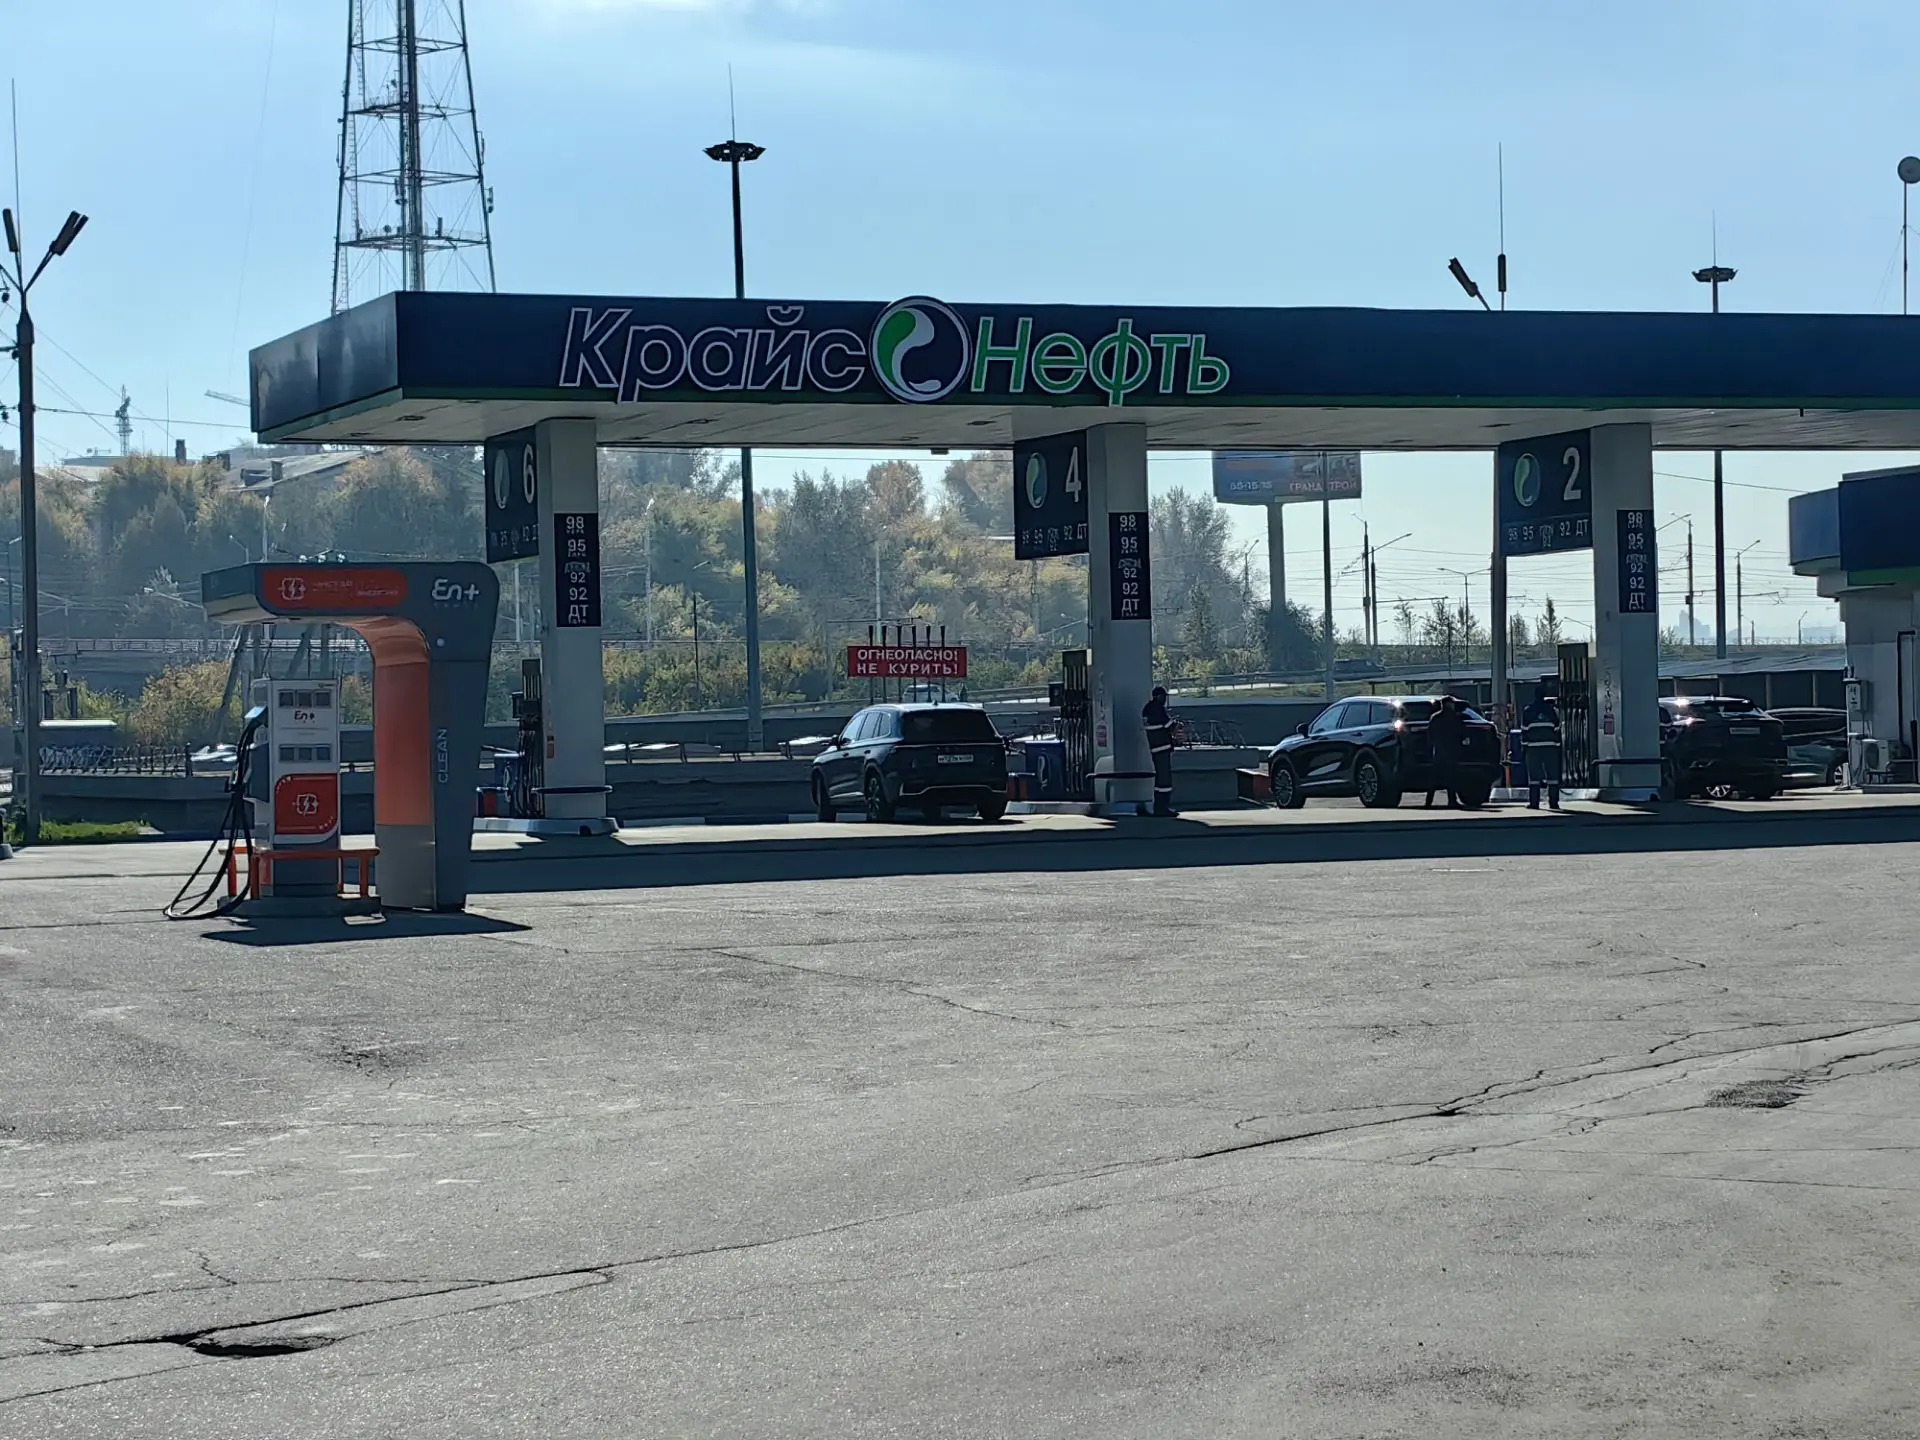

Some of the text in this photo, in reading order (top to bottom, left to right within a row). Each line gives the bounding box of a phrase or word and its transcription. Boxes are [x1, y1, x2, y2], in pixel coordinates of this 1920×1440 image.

[559, 305, 1231, 407] Крайс Нефть
[523, 444, 535, 504] 6
[1065, 446, 1082, 503] 4
[1562, 446, 1582, 501] 2
[566, 516, 584, 530] 98
[1120, 514, 1137, 528] 98
[1627, 511, 1643, 524] 98
[1576, 519, 1589, 537] ДТ
[567, 539, 587, 552] 95
[1121, 536, 1138, 550] 95
[1628, 532, 1644, 545] 95
[1123, 567, 1137, 579] 92
[1630, 562, 1644, 573] 92
[570, 572, 586, 583] 92
[1629, 576, 1645, 590] 92
[431, 579, 480, 601] En+
[569, 587, 588, 601] 92
[1122, 582, 1138, 595] 92
[1121, 598, 1140, 613] ДТ
[1629, 591, 1646, 607] ДТ
[568, 604, 590, 619] ДТ
[857, 649, 959, 662] ОГНЕОПАСНО!
[857, 663, 958, 675] НЕ КУРИТЬ!
[438, 728, 448, 783] CLEAN
